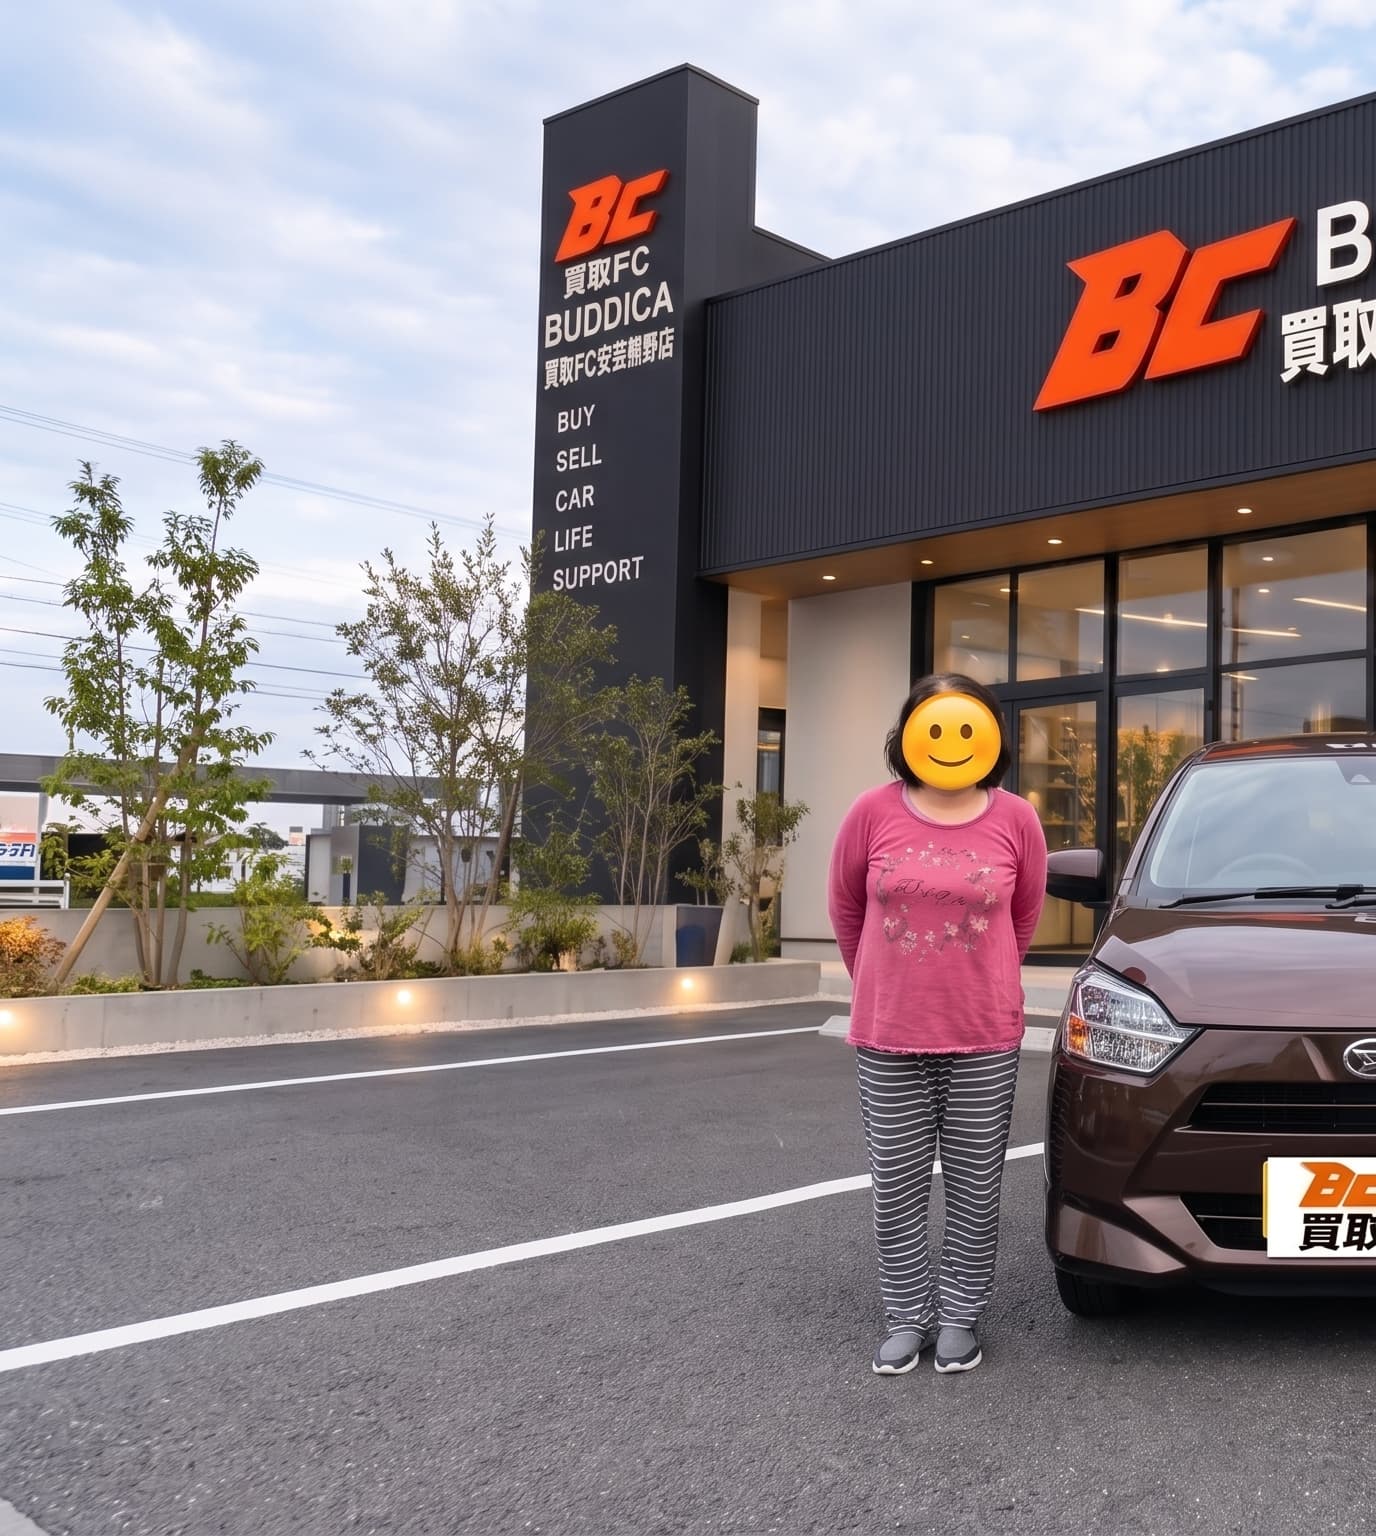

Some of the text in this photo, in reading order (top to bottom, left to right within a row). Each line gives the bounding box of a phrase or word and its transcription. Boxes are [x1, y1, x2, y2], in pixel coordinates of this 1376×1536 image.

[554, 169, 669, 263] BC
[563, 245, 650, 300] 買取FC
[544, 280, 674, 349] BUDDICA
[1033, 217, 1296, 412] BC
[557, 403, 596, 434] BUY
[556, 443, 603, 473] SELL
[555, 484, 595, 512] CAR
[554, 524, 594, 553] LIFE
[552, 555, 645, 592] SUPPORT
